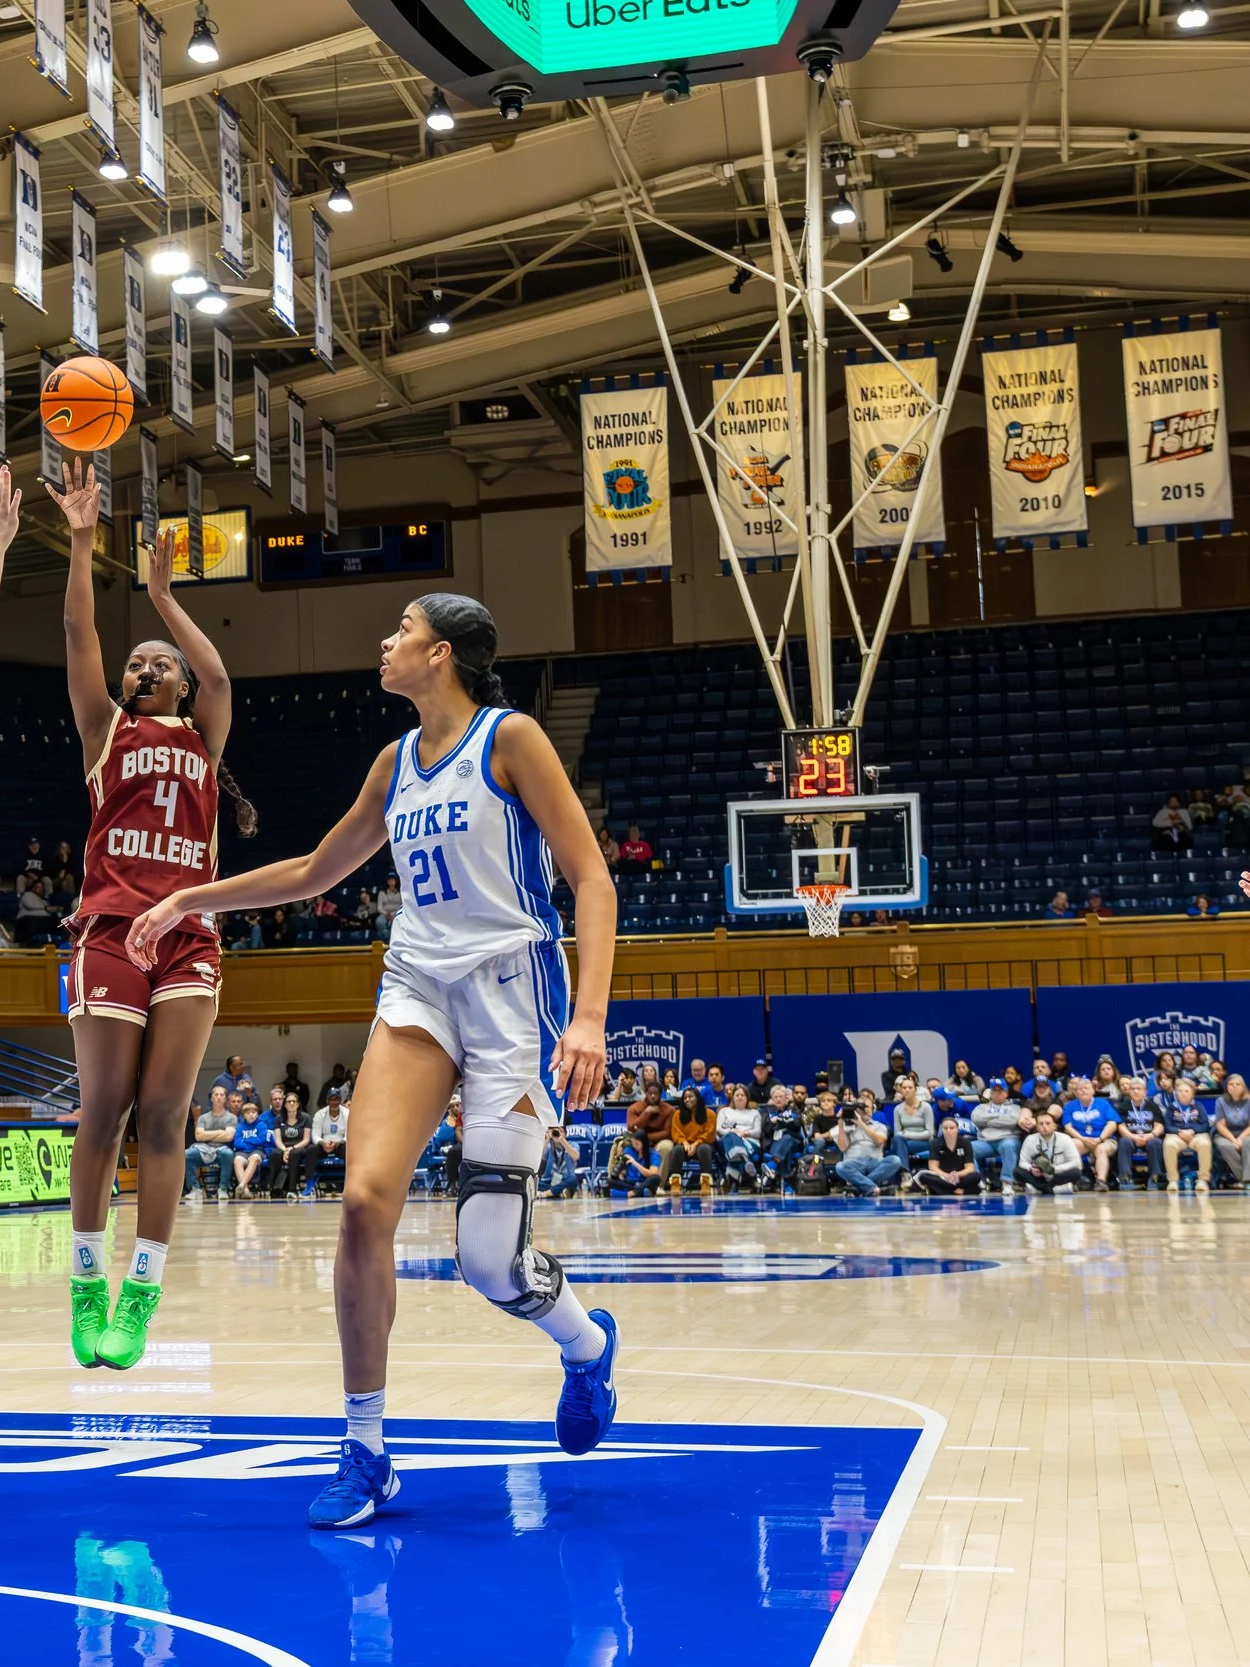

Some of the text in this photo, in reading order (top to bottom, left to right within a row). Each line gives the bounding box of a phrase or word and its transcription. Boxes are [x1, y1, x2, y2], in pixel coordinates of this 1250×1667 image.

[566, 0, 649, 28] Uber
[1138, 355, 1208, 376] NATIONAL
[998, 369, 1064, 389] NATIONAL
[1132, 374, 1218, 397] CHAMPIONS
[860, 383, 923, 402] NATIONAL
[992, 388, 1074, 410] CHAMPIONS
[727, 397, 788, 416] NATIONAL
[853, 402, 930, 422] CHAMPIONS
[594, 411, 656, 430] NATIONAL
[720, 417, 789, 436] CHAMPION
[587, 429, 663, 450] CHAMPIONS
[1022, 424, 1067, 441] FINAL
[1004, 438, 1069, 462] FOUR
[615, 459, 632, 467] 1991
[1161, 483, 1204, 500] 2015
[1020, 495, 1061, 512] 2010
[879, 507, 913, 523] 200
[744, 519, 783, 536] 1992
[268, 535, 304, 548] DUKE
[610, 531, 648, 548] 1991
[811, 735, 850, 756] 1:58
[121, 746, 208, 790] BOSTON
[799, 757, 846, 795] 23
[153, 780, 179, 828] 4
[393, 801, 468, 844] DUKE
[107, 828, 207, 870] COLLEGE
[409, 845, 460, 907] 21
[1170, 1023, 1180, 1031] THE
[635, 1036, 644, 1044] THE
[1135, 1031, 1217, 1053] SISTERHOOD
[606, 1044, 677, 1065] SISTERHOOD
[52, 1145, 72, 1168] wa
